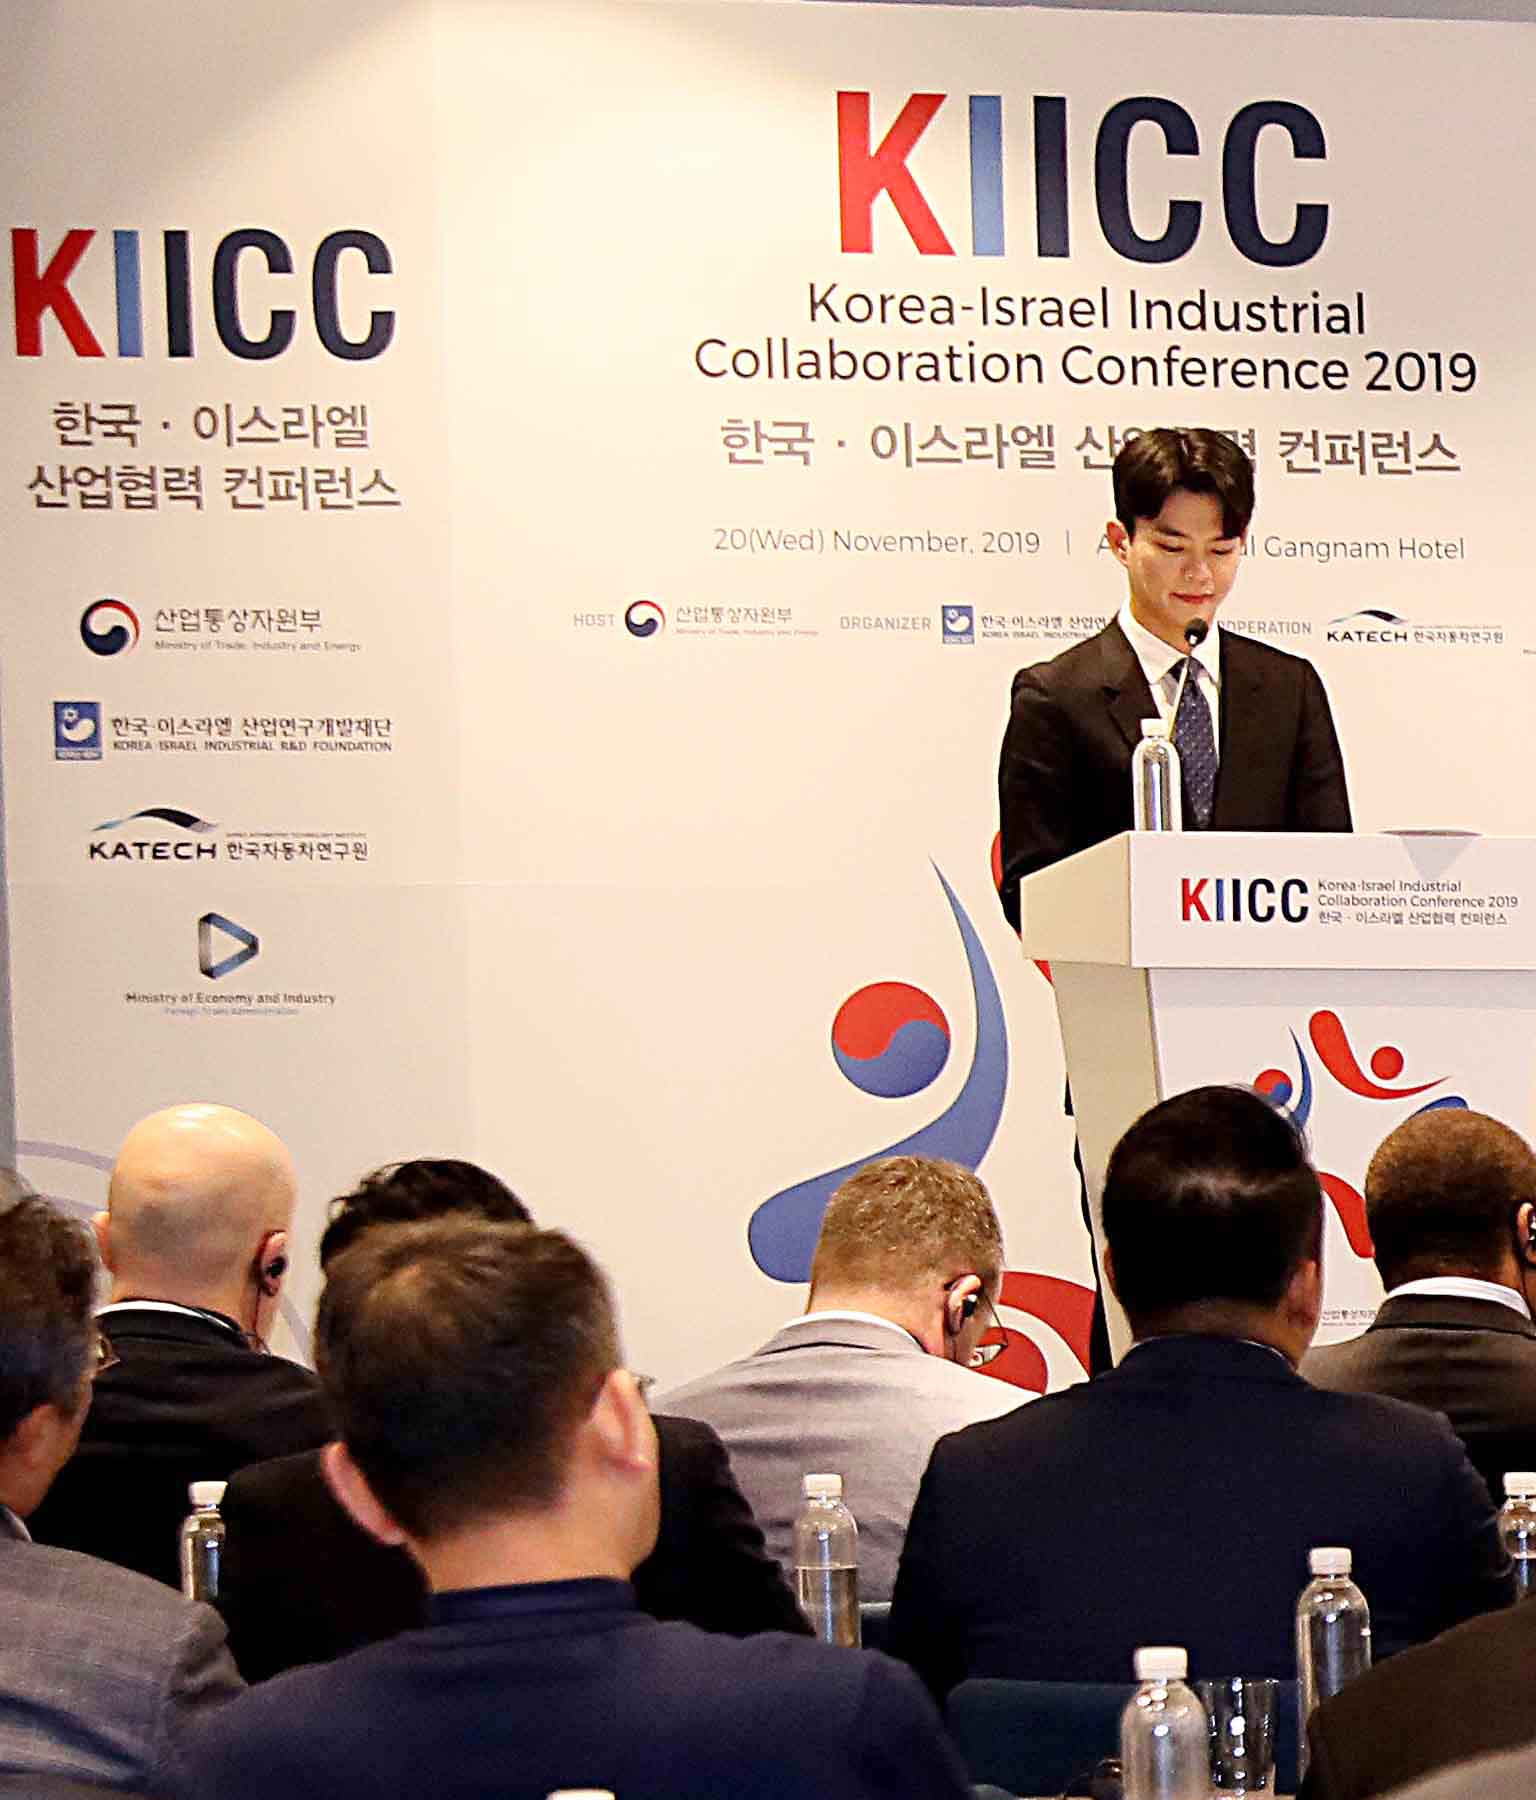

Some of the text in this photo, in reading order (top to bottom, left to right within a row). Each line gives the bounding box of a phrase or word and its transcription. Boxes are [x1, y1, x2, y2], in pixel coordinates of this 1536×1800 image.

[836, 90, 1330, 268] KIICC
[10, 228, 396, 360] KIICC
[807, 283, 1366, 335] Korea-Israel Industrial
[694, 338, 1478, 393] Collaboration Conference 2019
[53, 402, 370, 449] 한국 이스라엘
[720, 418, 815, 467] 한국
[870, 423, 1057, 470] 이스라엘
[1279, 432, 1461, 476] 컨퍼런스
[27, 465, 402, 511] 산업협력 컨퍼런스
[713, 529, 825, 552] 20(Wed)
[833, 530, 974, 555] November,
[982, 531, 1040, 554] 2019
[1264, 535, 1391, 564] Gangnam
[1400, 537, 1465, 560] Hotel
[155, 608, 321, 633] 산업통상자원부
[573, 613, 615, 627] HOST
[840, 616, 931, 630] ORGANIZER
[1327, 632, 1407, 643] KATECH
[244, 717, 392, 737] 산업연구개발재단
[204, 741, 273, 751] INDUSTRIAL
[313, 741, 392, 751] FOUNDATION
[89, 842, 216, 860] KATECH
[1400, 880, 1461, 892] Industrial
[1181, 878, 1309, 922] KIICC
[1318, 895, 1518, 908] Collaboration Conference 2019
[1319, 911, 1342, 924] 한국
